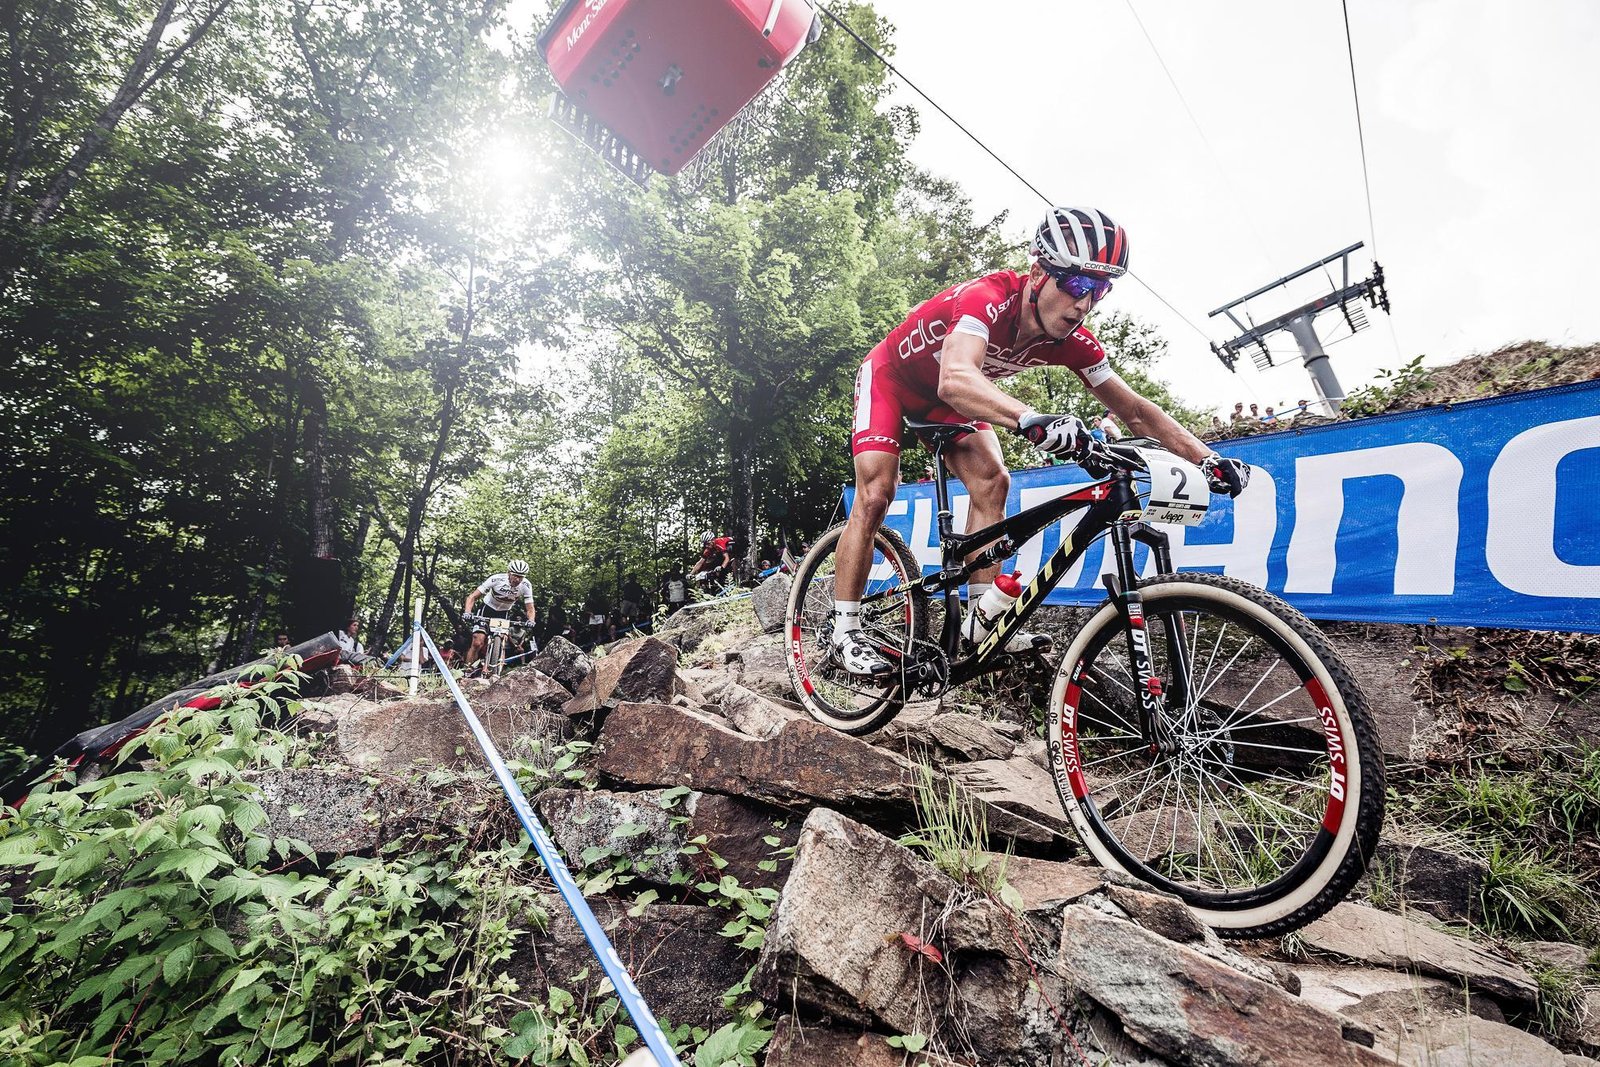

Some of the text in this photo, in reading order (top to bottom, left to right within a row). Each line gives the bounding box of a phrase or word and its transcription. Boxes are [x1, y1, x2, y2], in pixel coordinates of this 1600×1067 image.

[1170, 466, 1190, 501] 2
[977, 526, 1079, 664] SCOTT
[1131, 629, 1149, 658] DT
[1135, 660, 1157, 710] SWISS
[1062, 702, 1080, 774] DT SWISS
[1317, 706, 1346, 803] DT SWISS
